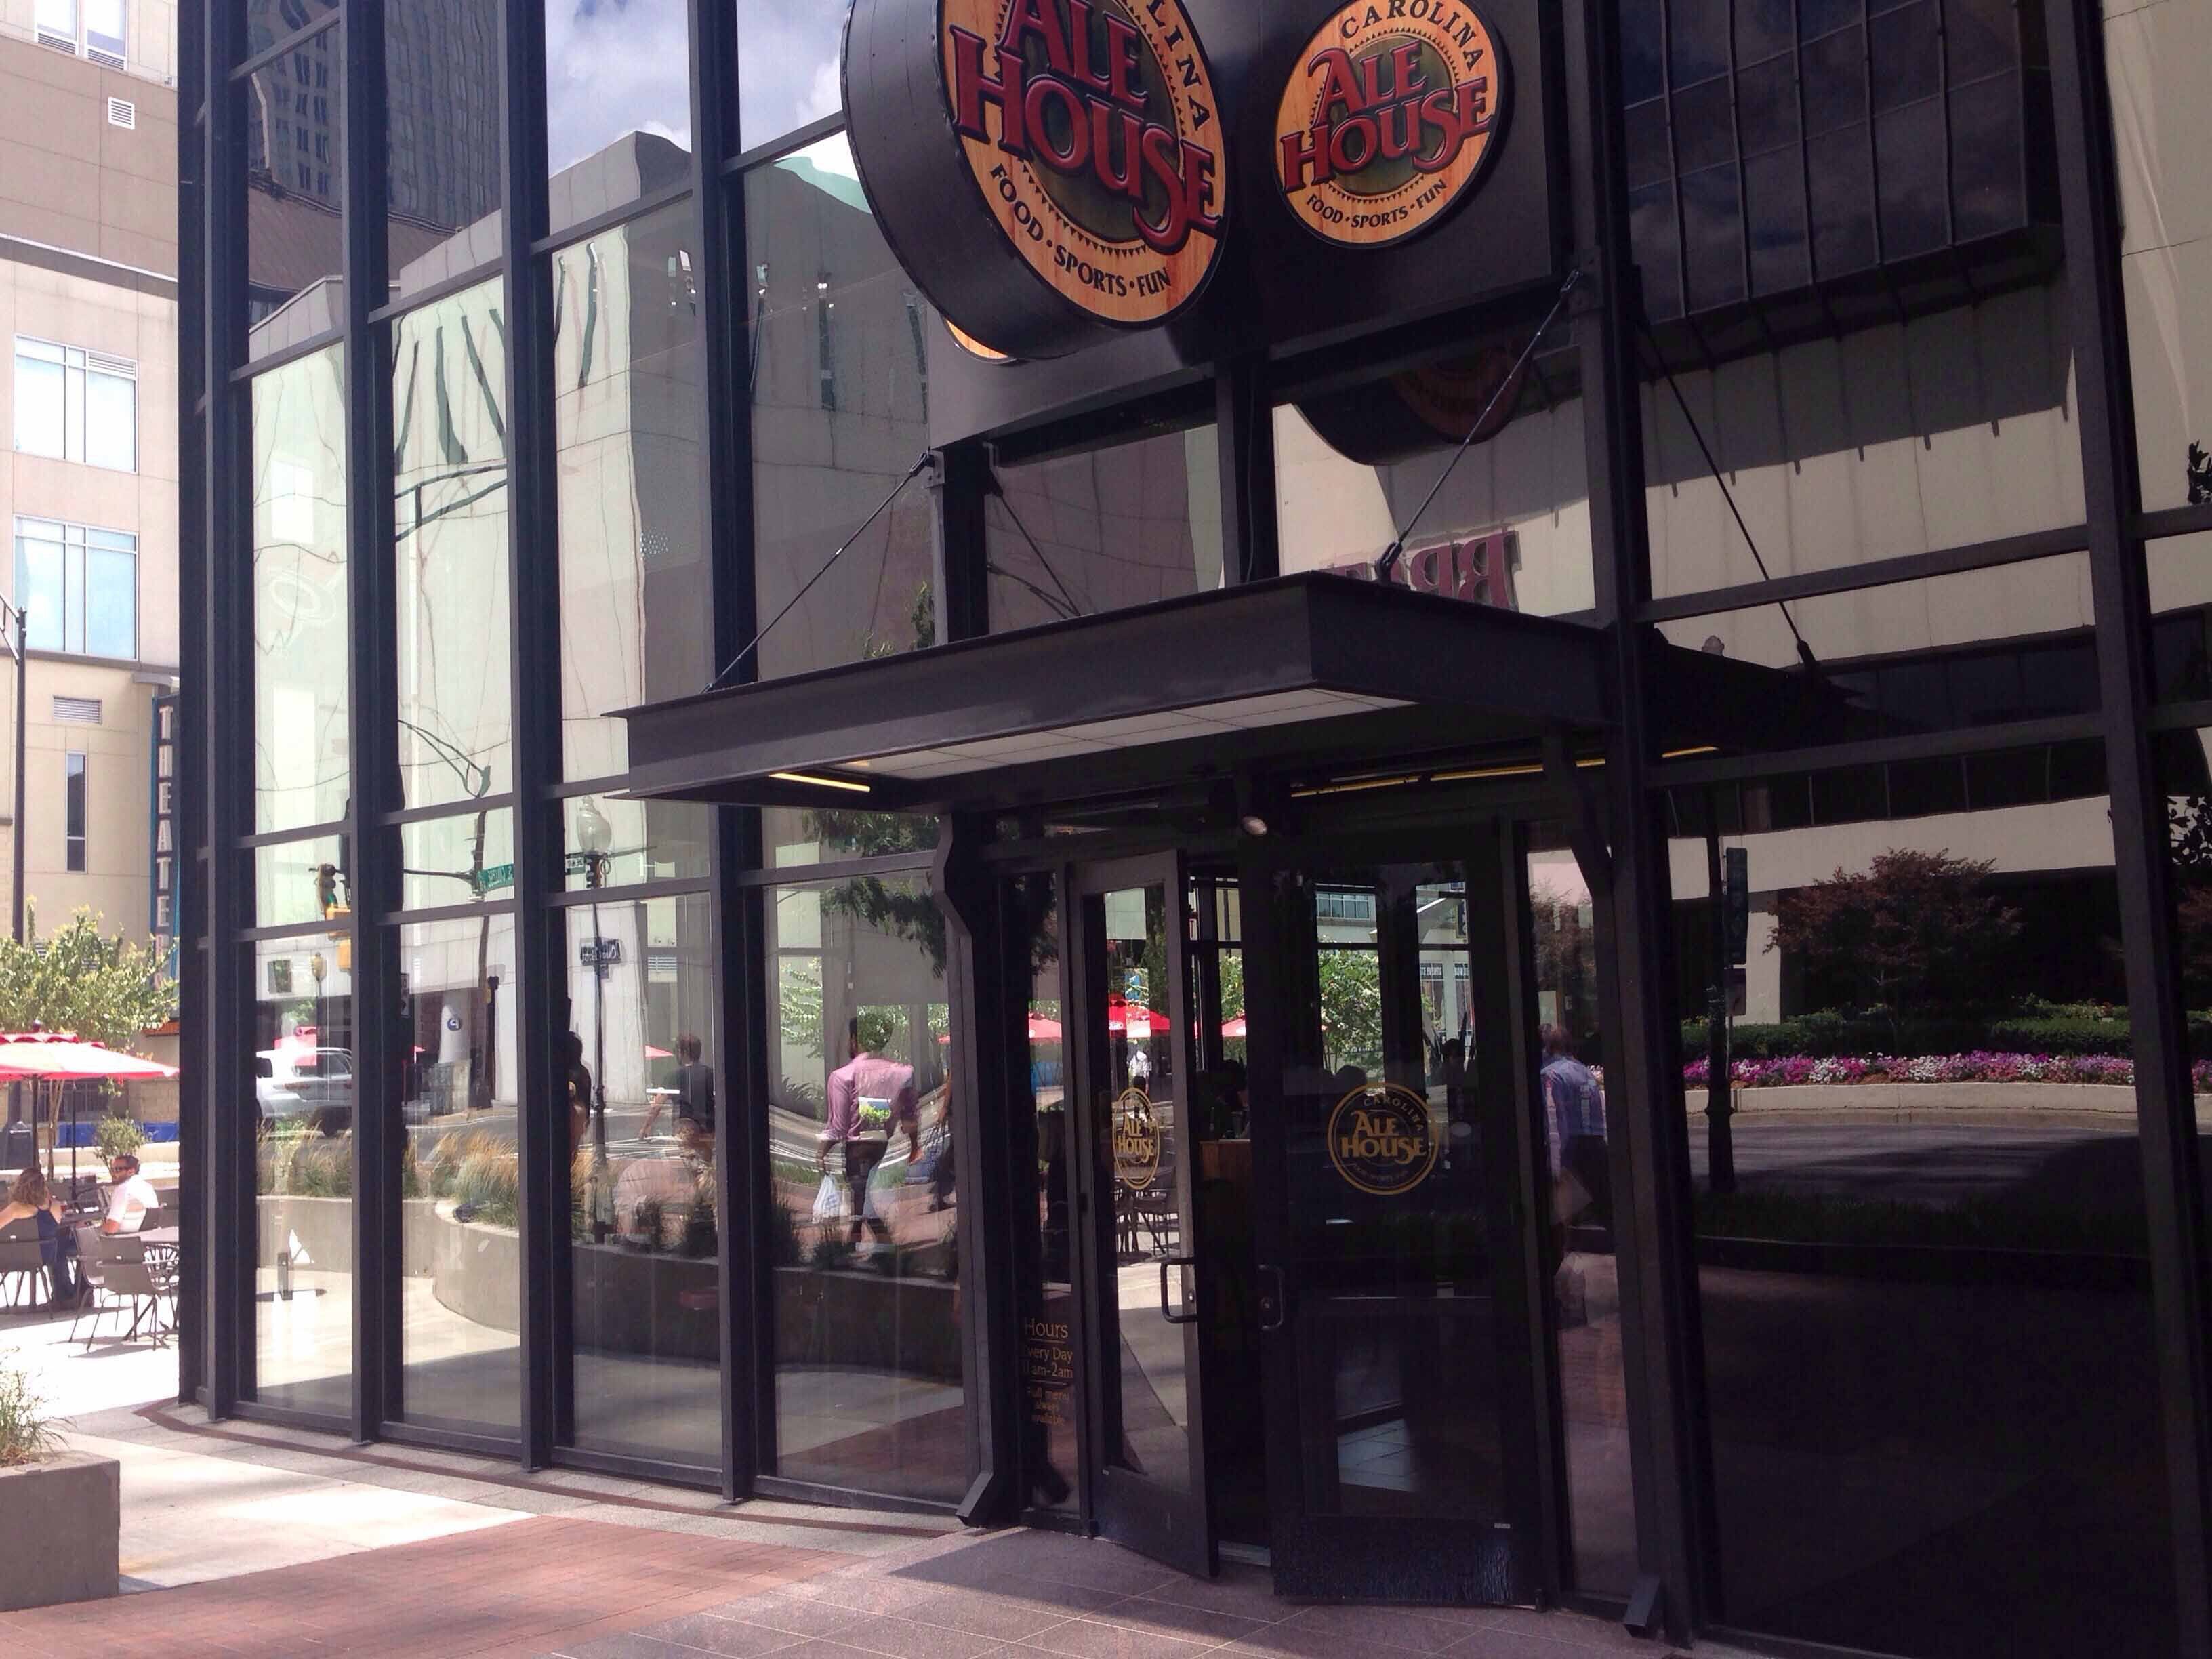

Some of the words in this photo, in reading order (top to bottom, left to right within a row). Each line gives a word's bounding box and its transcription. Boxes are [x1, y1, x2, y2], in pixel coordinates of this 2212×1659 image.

[995, 0, 1150, 108] ALE
[1341, 0, 1486, 71] CAROLINA
[1308, 40, 1429, 127] ALE
[947, 24, 1222, 255] HOUSE
[1280, 77, 1493, 192] HOUSE
[1307, 194, 1343, 224] FOOD
[1351, 205, 1409, 228] SPORTS
[1416, 178, 1448, 209] FUN
[991, 163, 1044, 248] FOOD
[1053, 243, 1127, 297] SPORTS
[1137, 266, 1172, 298] FUN
[1122, 1112, 1143, 1136] ALE
[1351, 1110, 1399, 1139] ALE
[1117, 1135, 1154, 1164] HOUSE
[1339, 1136, 1429, 1165] HOUSE
[1024, 1317, 1069, 1338] Hours
[1025, 1345, 1050, 1361] very
[1052, 1346, 1074, 1365] Day
